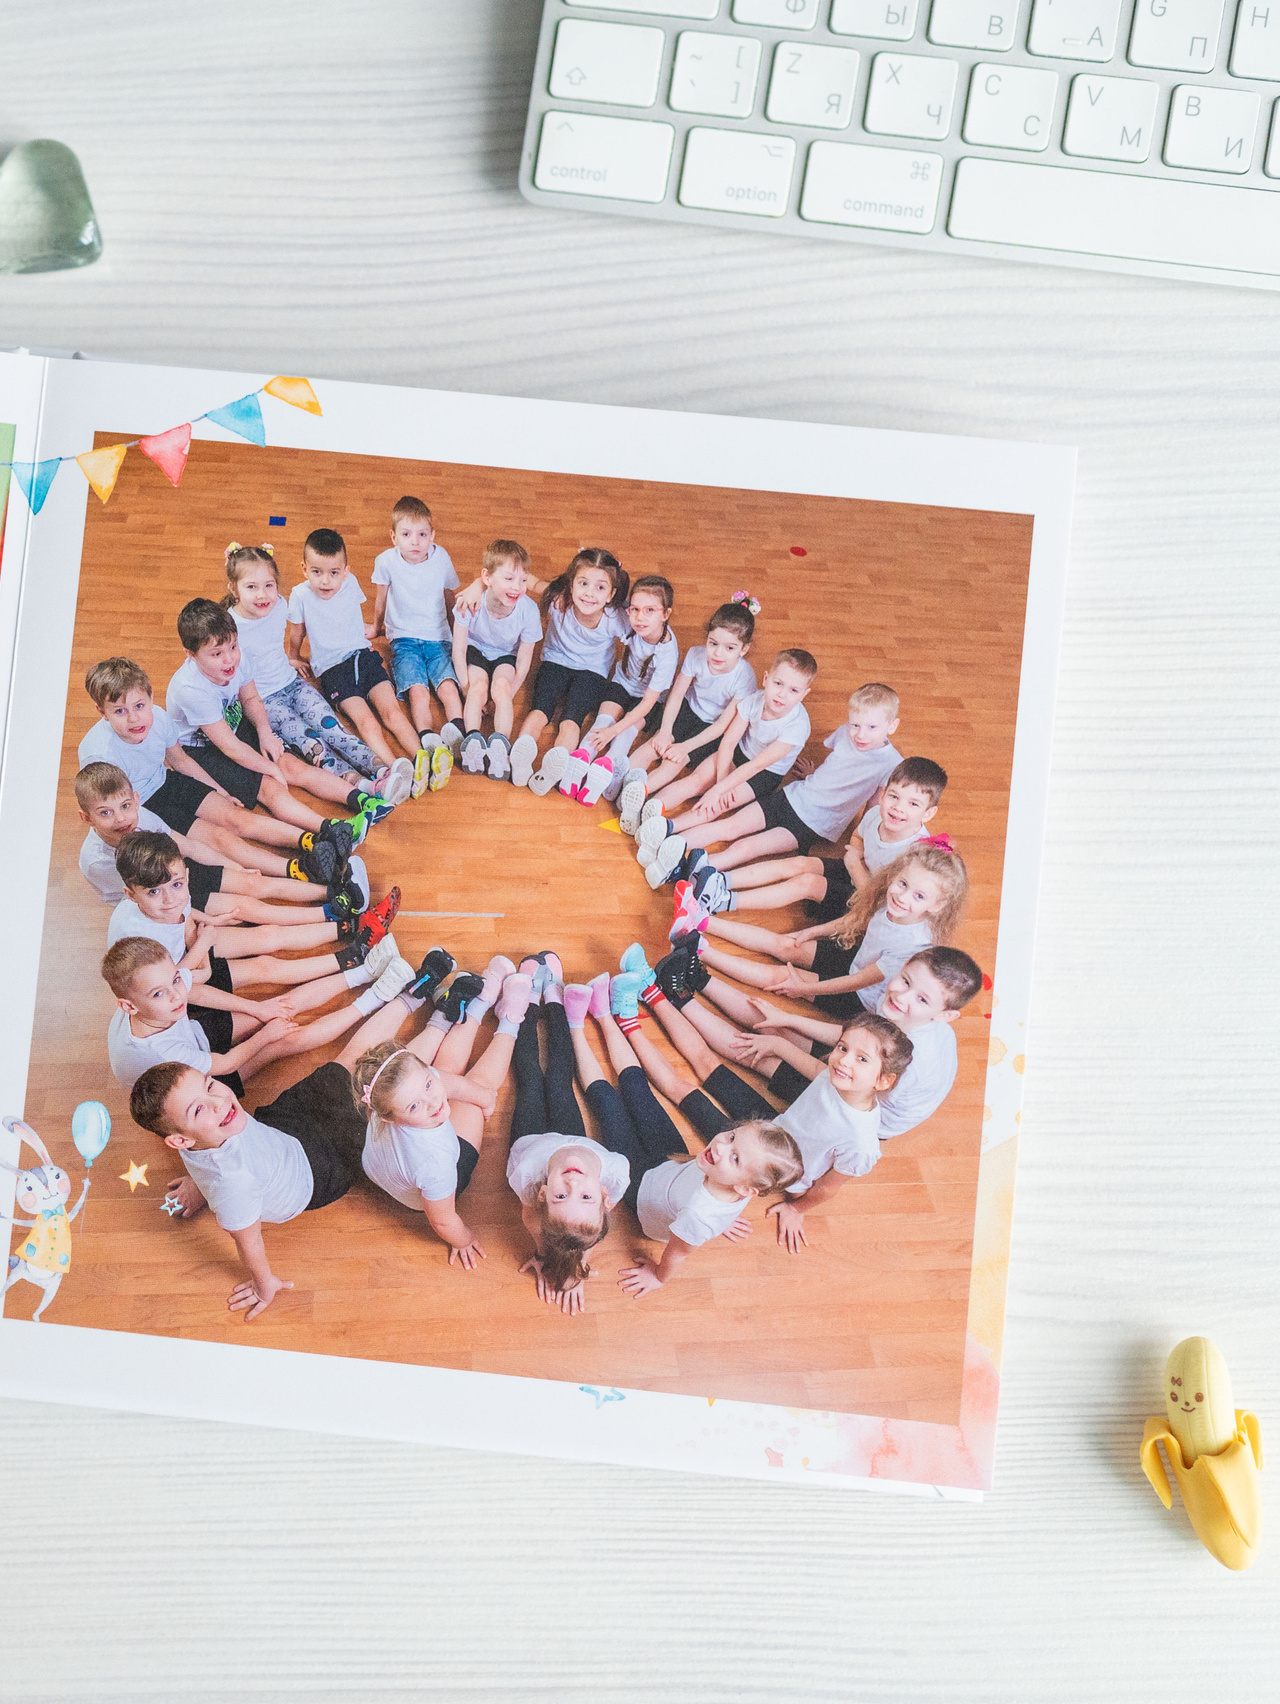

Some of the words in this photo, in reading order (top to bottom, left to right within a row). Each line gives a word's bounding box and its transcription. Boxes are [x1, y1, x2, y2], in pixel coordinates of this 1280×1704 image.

[885, 4, 908, 26] Ы
[1150, 0, 1167, 17] G
[1251, 6, 1270, 28] H
[1189, 36, 1208, 58] П
[786, 52, 803, 74] Z
[885, 63, 904, 85] X
[984, 74, 1002, 96] C
[1087, 85, 1104, 107] V
[824, 93, 842, 115] Я
[926, 103, 943, 126] Ч
[1185, 96, 1202, 117] B
[1224, 137, 1244, 159] И
[549, 163, 608, 183] control
[725, 184, 778, 204] option
[843, 197, 925, 219] command
